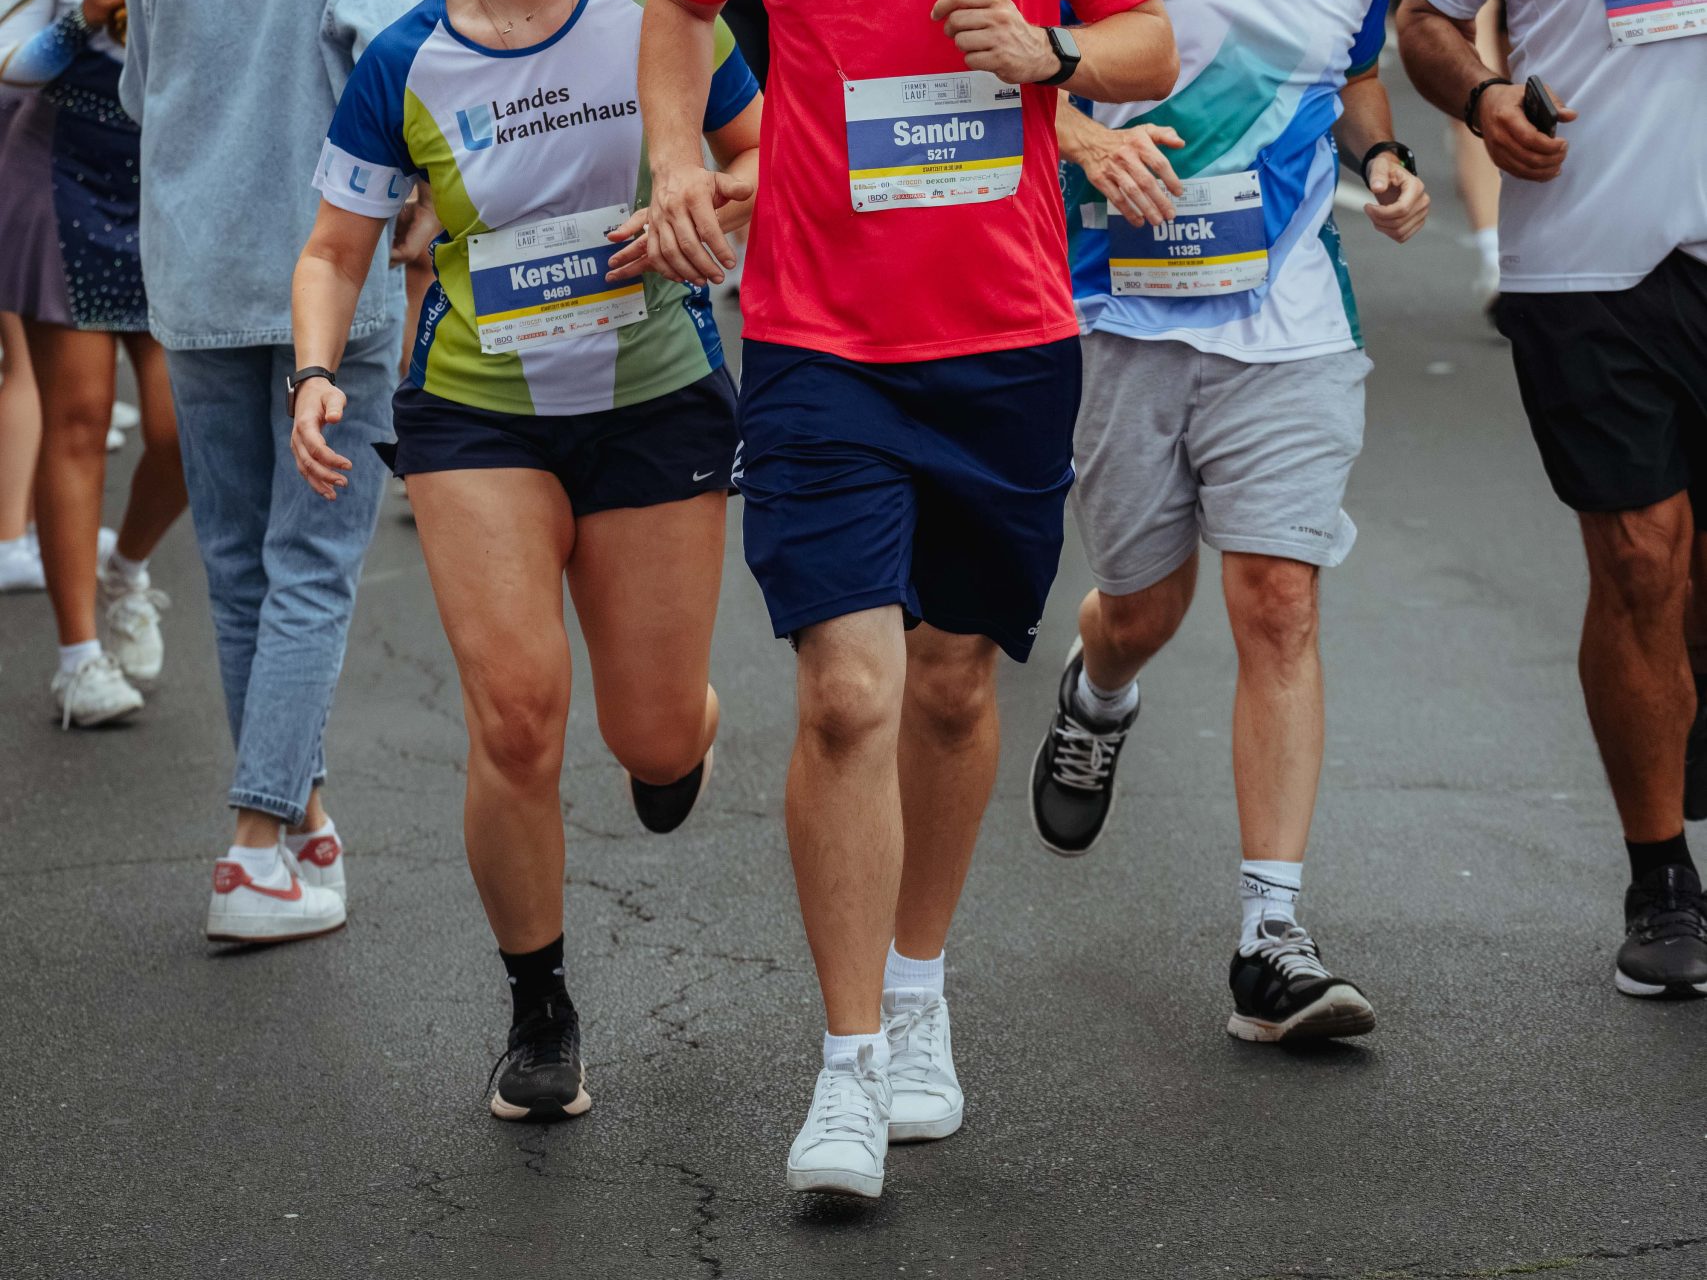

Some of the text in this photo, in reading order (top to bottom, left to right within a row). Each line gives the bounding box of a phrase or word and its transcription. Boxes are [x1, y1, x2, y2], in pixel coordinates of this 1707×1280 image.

[905, 90, 927, 100] LAUF
[492, 87, 570, 120] Landes
[496, 100, 637, 144] krankenhaus
[893, 117, 985, 146] Sandro
[927, 148, 956, 161] 5217
[870, 193, 888, 202] BDO
[1153, 218, 1215, 241] Dirck
[517, 235, 536, 247] LAUF
[1168, 245, 1201, 256] 11325
[509, 255, 597, 290] Kerstin
[543, 285, 571, 300] 9469
[496, 335, 513, 344] BDO
